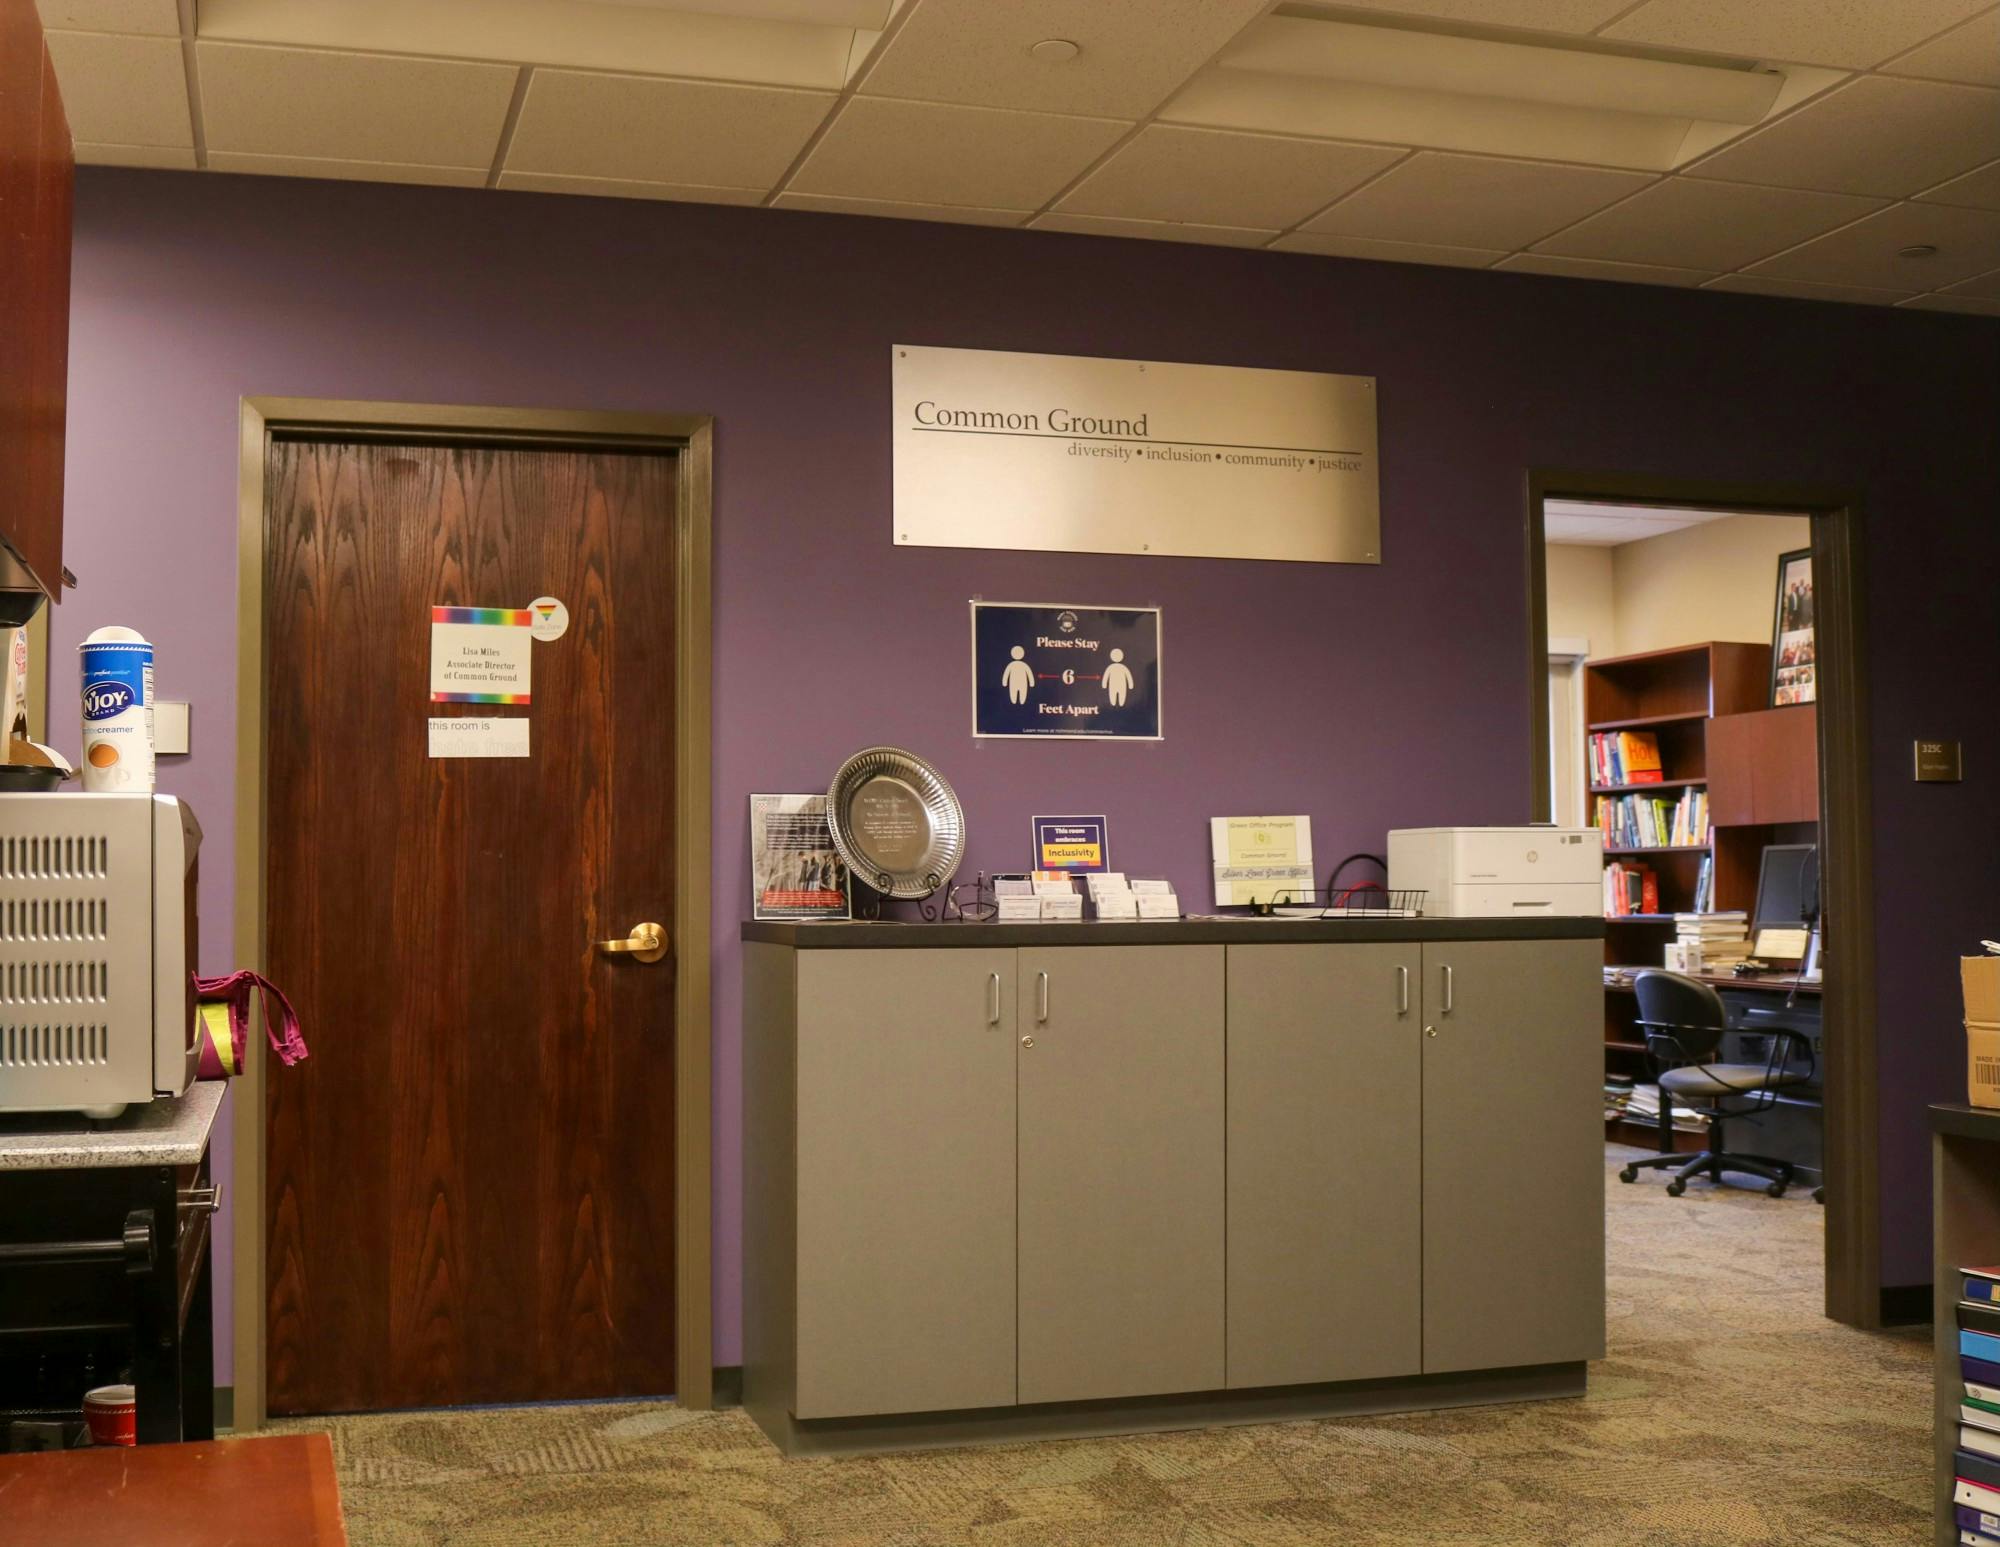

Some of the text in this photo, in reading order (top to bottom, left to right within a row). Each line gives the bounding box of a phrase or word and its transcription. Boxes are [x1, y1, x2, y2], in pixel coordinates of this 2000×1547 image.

[914, 401, 1149, 437] Common Ground
[1067, 442, 1362, 473] diversity inclusion community justice
[1036, 637, 1100, 651] Please Stay
[462, 647, 500, 656] Lisa Miles
[447, 660, 516, 670] Associate Director
[444, 672, 517, 682] of Common Ground
[1062, 669, 1075, 685] 6
[1038, 703, 1099, 716] Feet Apart
[428, 721, 491, 731] this room is
[1048, 849, 1095, 859] Inclusivity
